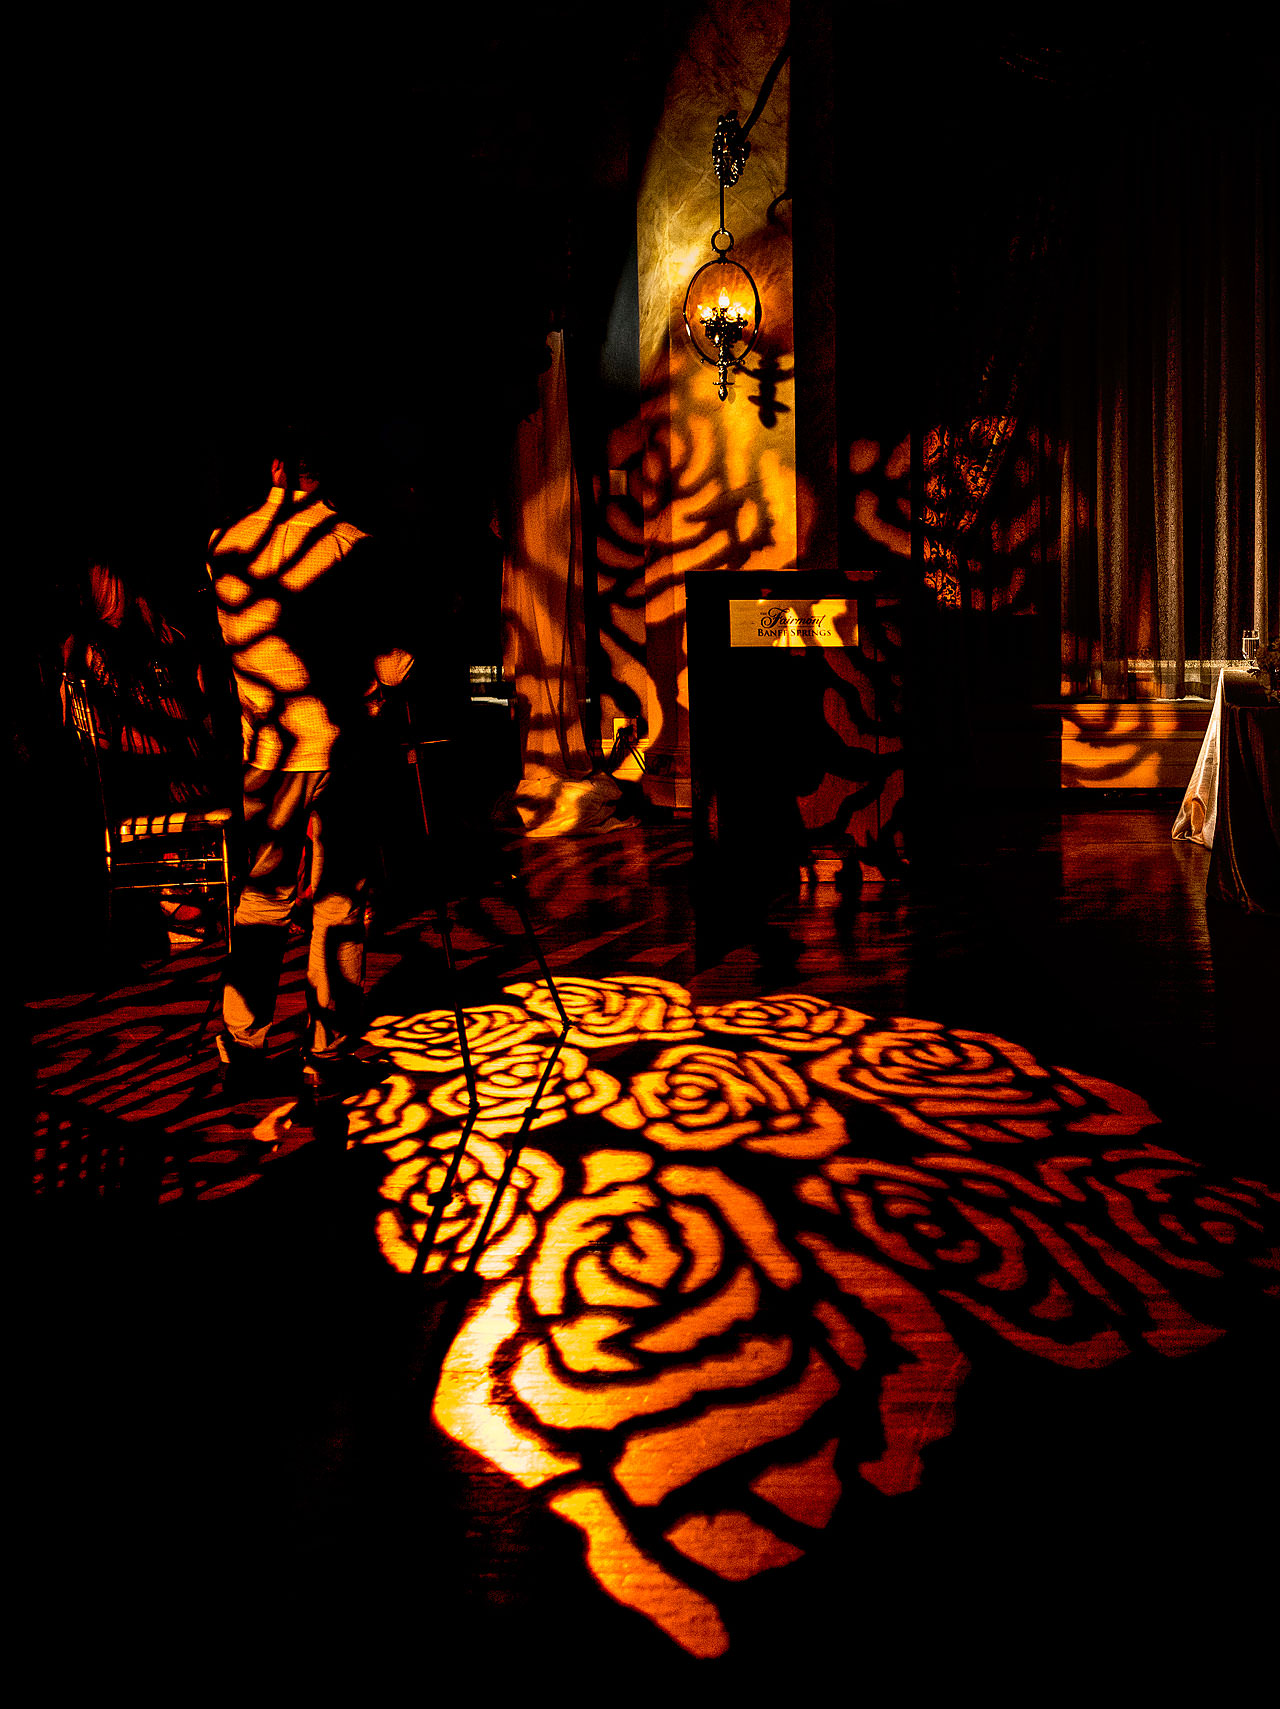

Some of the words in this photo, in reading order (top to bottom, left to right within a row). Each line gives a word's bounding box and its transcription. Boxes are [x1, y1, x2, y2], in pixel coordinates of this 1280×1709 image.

[761, 607, 826, 628] Fairmont
[757, 628, 788, 637] BANFF
[790, 628, 832, 637] SPRINGS
